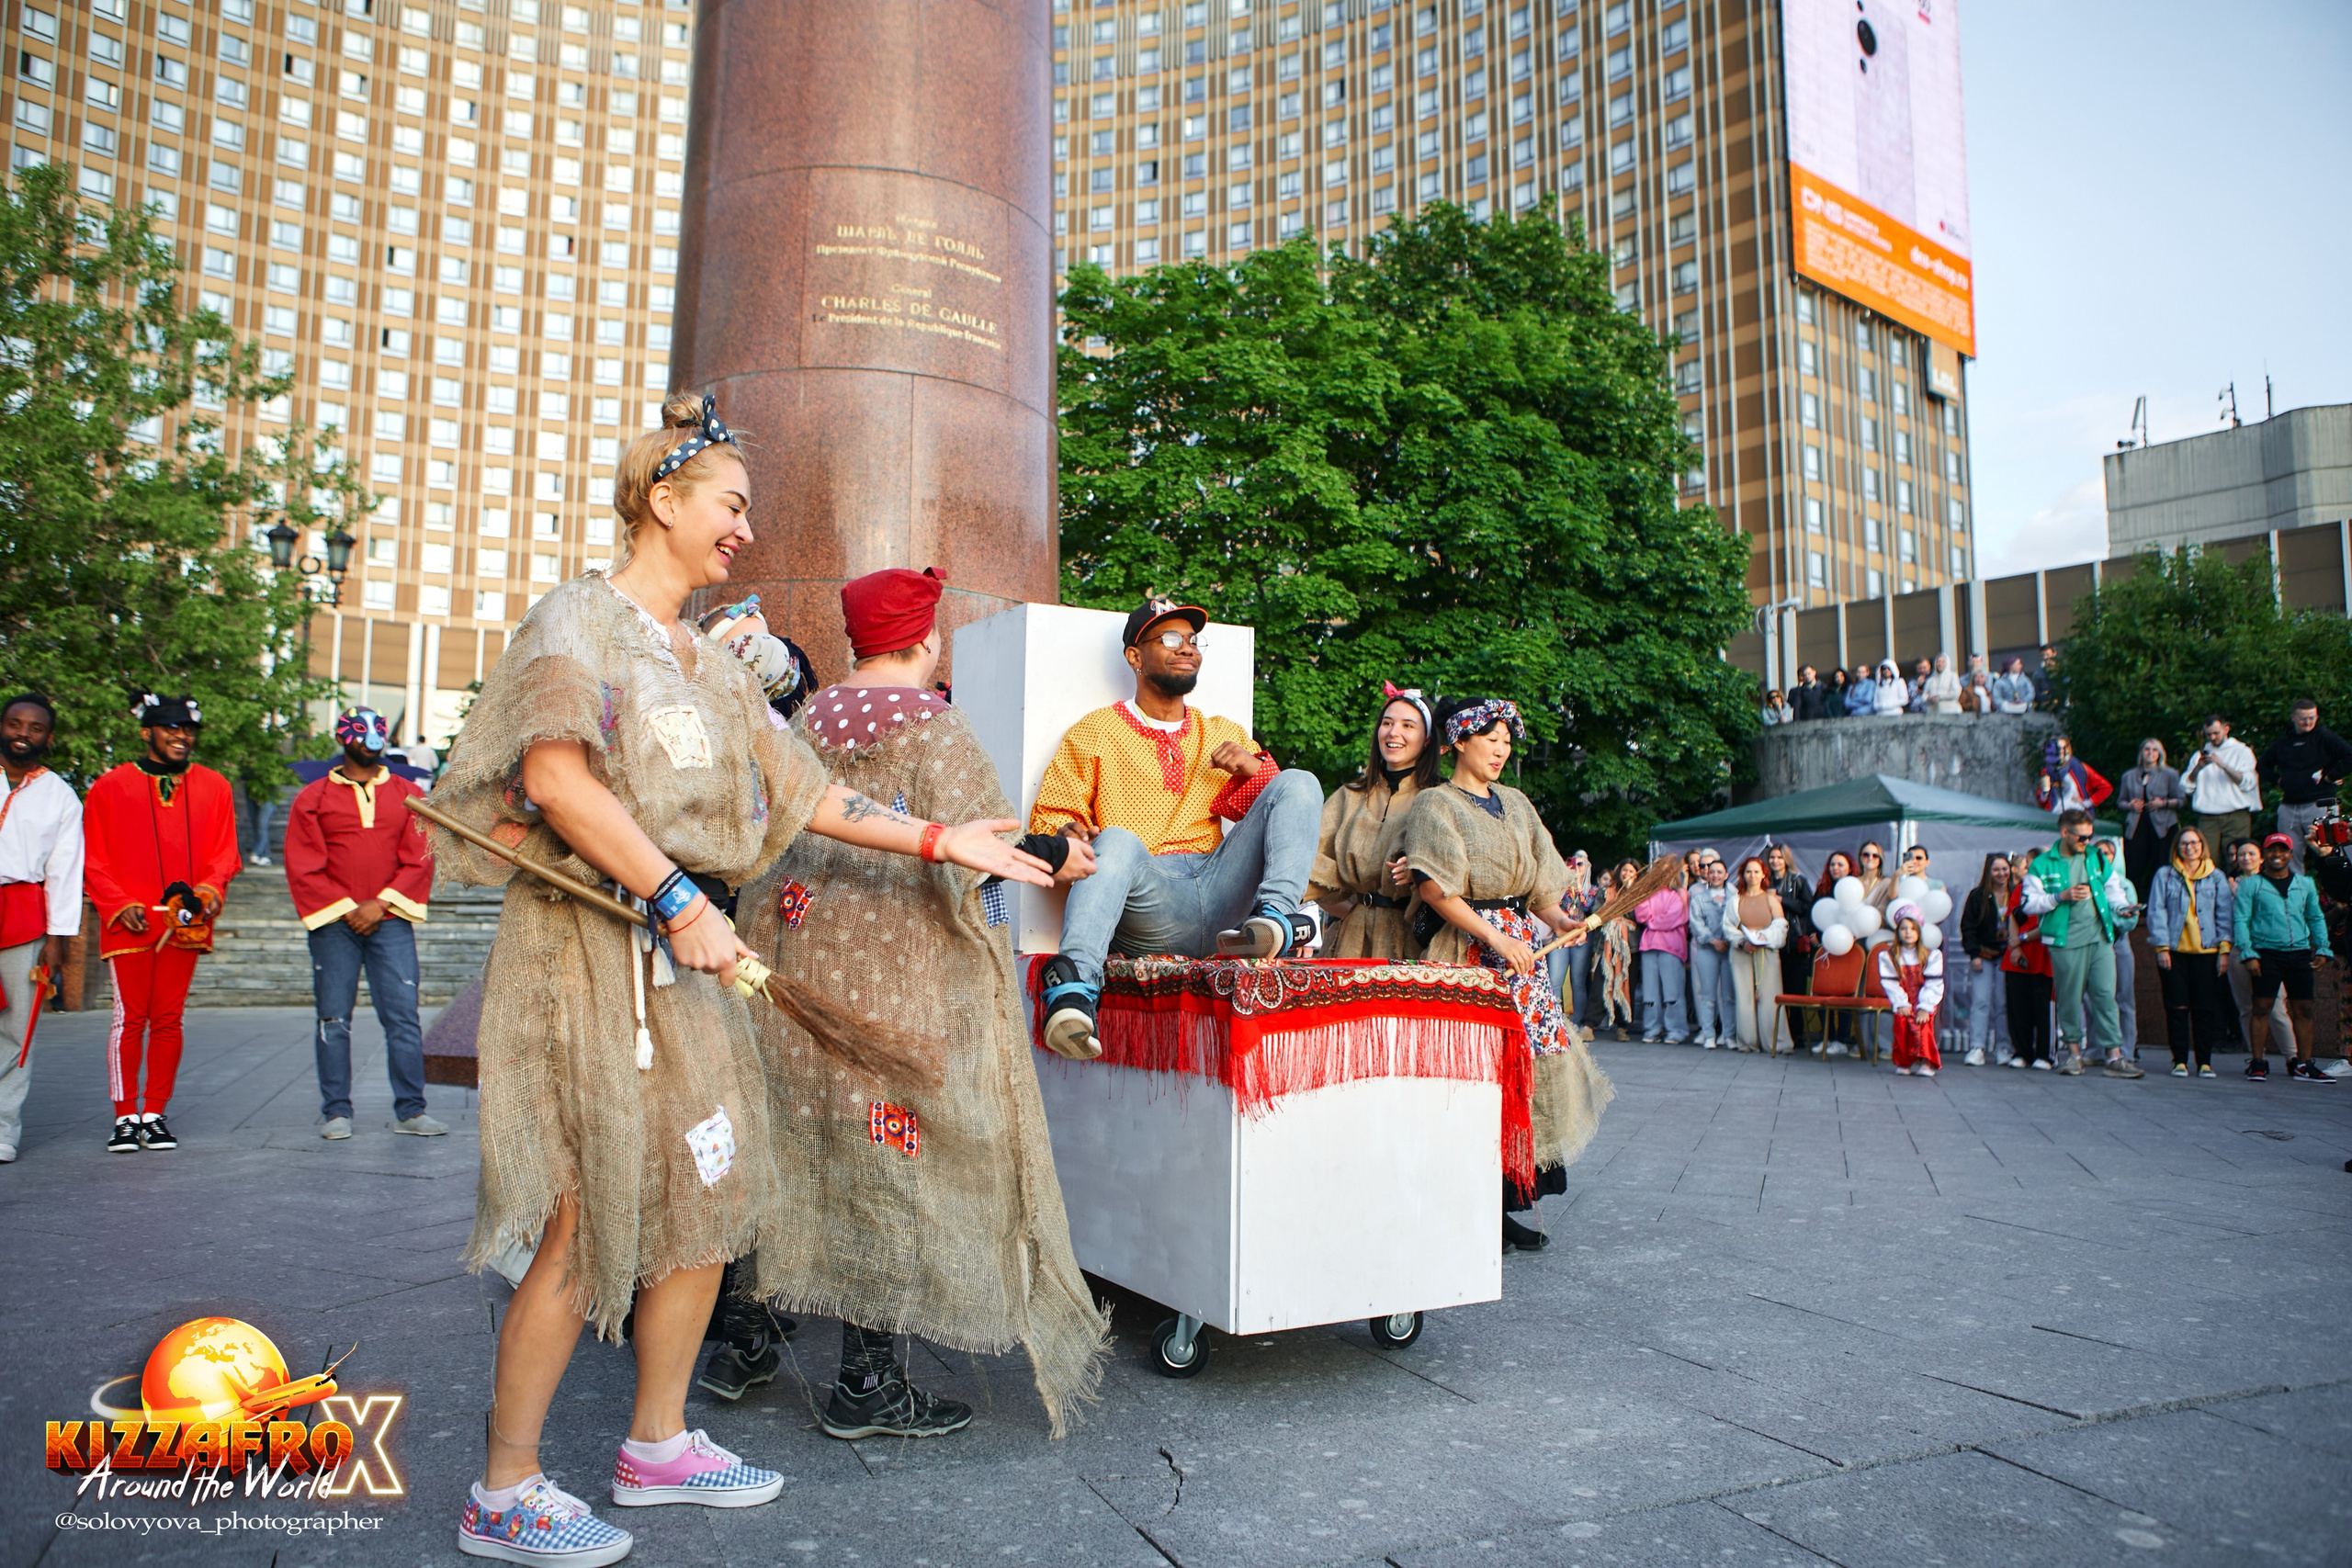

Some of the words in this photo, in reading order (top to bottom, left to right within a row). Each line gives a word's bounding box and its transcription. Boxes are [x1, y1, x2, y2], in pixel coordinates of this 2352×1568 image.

[836, 224, 898, 242] ШАРЛЬ
[904, 230, 928, 246] ДЕ
[934, 235, 986, 260] ГОЛЛЬ
[820, 295, 902, 313] CHARLES
[910, 302, 932, 317] DE
[938, 308, 998, 335] GAULLE
[879, 314, 893, 326] de
[894, 316, 905, 328] la
